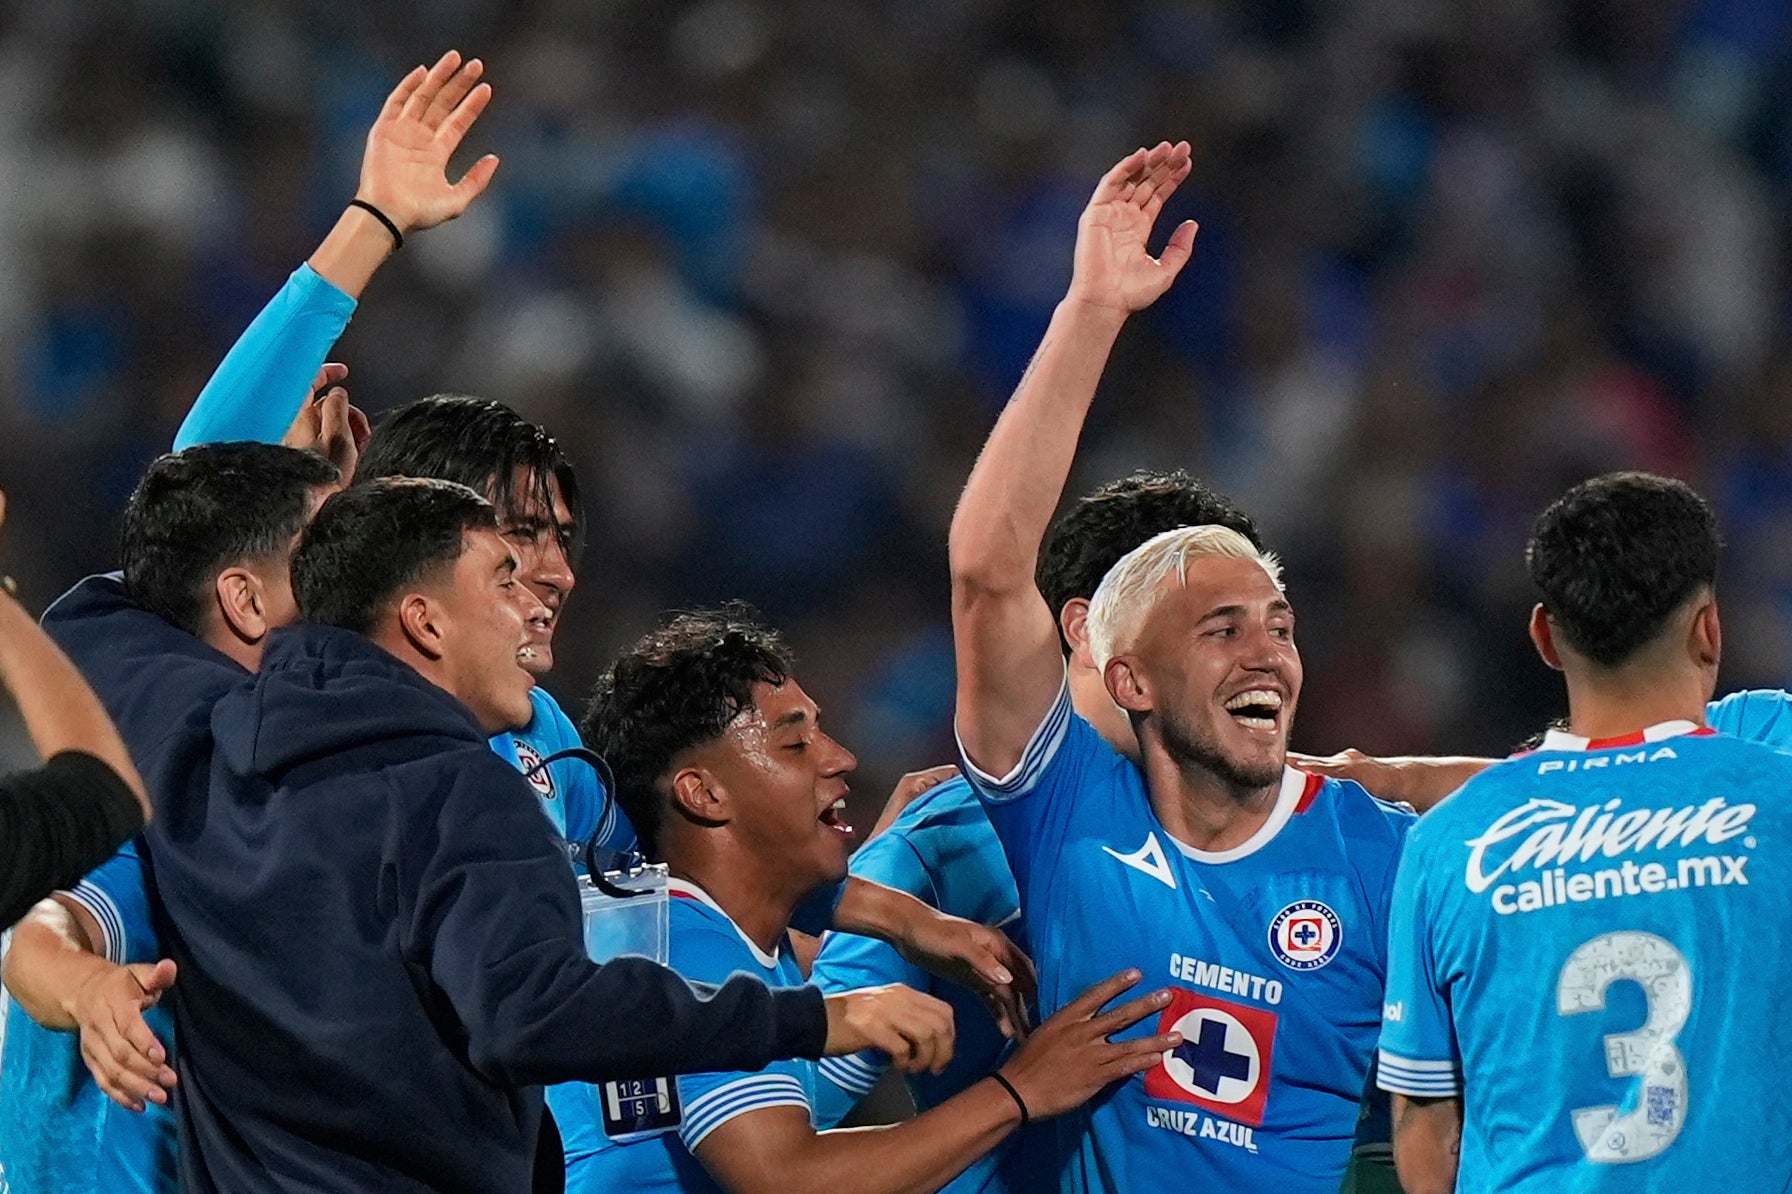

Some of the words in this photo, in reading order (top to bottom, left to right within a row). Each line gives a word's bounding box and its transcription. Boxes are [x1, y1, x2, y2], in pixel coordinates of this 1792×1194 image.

[1537, 747, 1678, 775] PIRMA
[1464, 797, 1757, 893] Caliente
[1491, 855, 1749, 916] caliente.mx
[1169, 953, 1283, 1005] CEMENTO
[1557, 931, 1692, 1163] 3
[1146, 1106, 1198, 1137] CRUZ
[1200, 1117, 1260, 1154] AZUL
